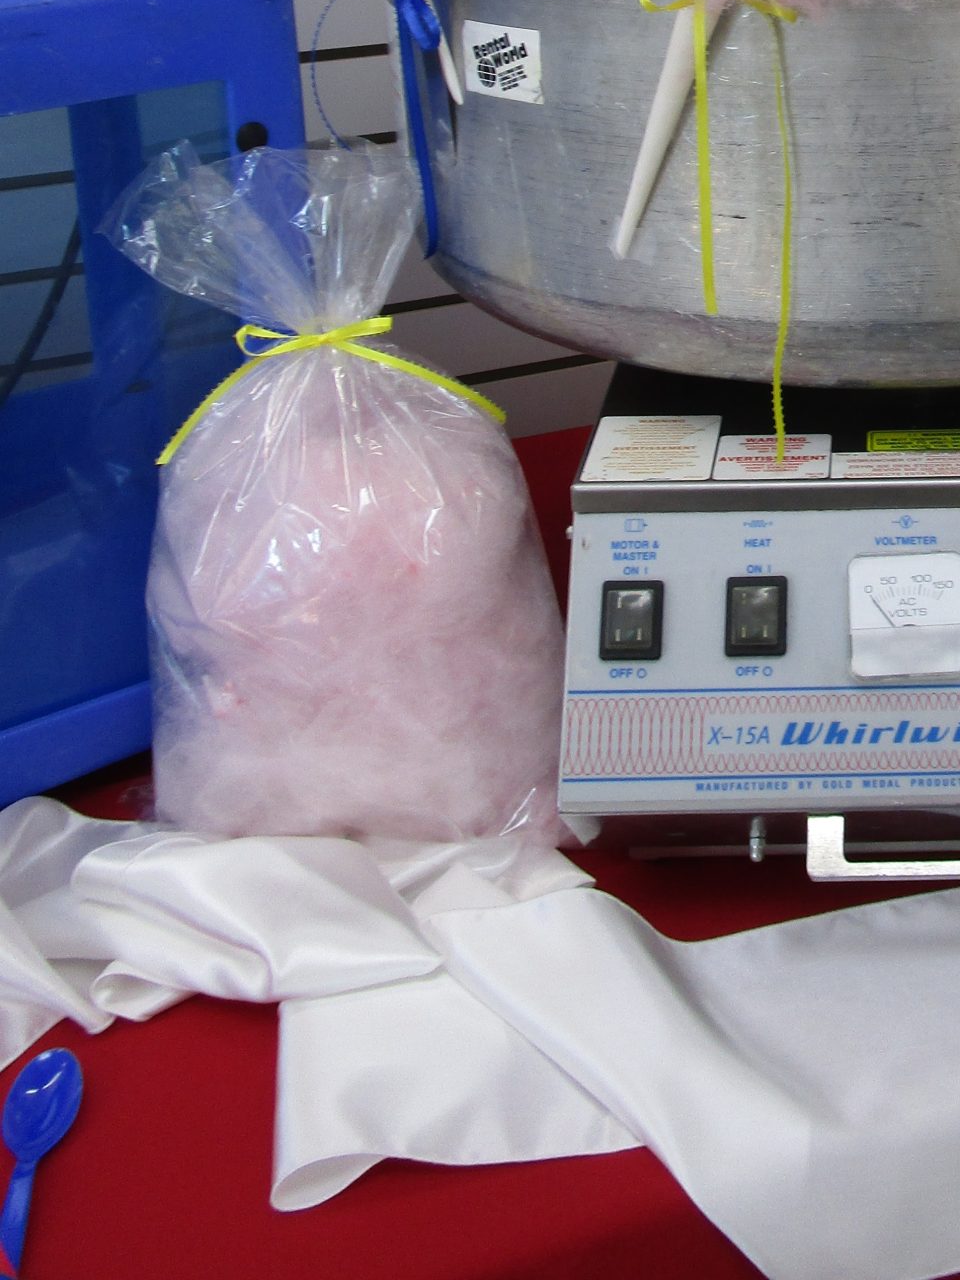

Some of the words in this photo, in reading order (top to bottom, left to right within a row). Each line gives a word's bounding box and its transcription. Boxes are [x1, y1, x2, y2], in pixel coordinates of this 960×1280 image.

[472, 32, 512, 60] Rental
[490, 42, 529, 68] World
[745, 436, 808, 444] WARING
[718, 454, 828, 463] AVERTISEMENT
[611, 540, 649, 549] MOTOR
[652, 540, 660, 549] &
[744, 538, 772, 548] HEAT
[874, 536, 938, 546] VOLTMETER
[612, 551, 657, 561] MASTER
[623, 566, 640, 576] ON
[746, 564, 762, 574] ON
[880, 576, 897, 585] 50
[911, 574, 932, 583] 100
[863, 585, 873, 594] 0
[932, 580, 954, 589] 150
[899, 597, 917, 606] AC
[888, 608, 928, 618] VOLTS
[609, 669, 633, 679] OFF
[735, 666, 759, 677] OFF
[707, 726, 771, 746] X-15A
[695, 780, 789, 792] MANUFACTURED
[798, 780, 813, 790] BY
[822, 780, 852, 790] GOLD
[862, 779, 901, 789] MEDAL
